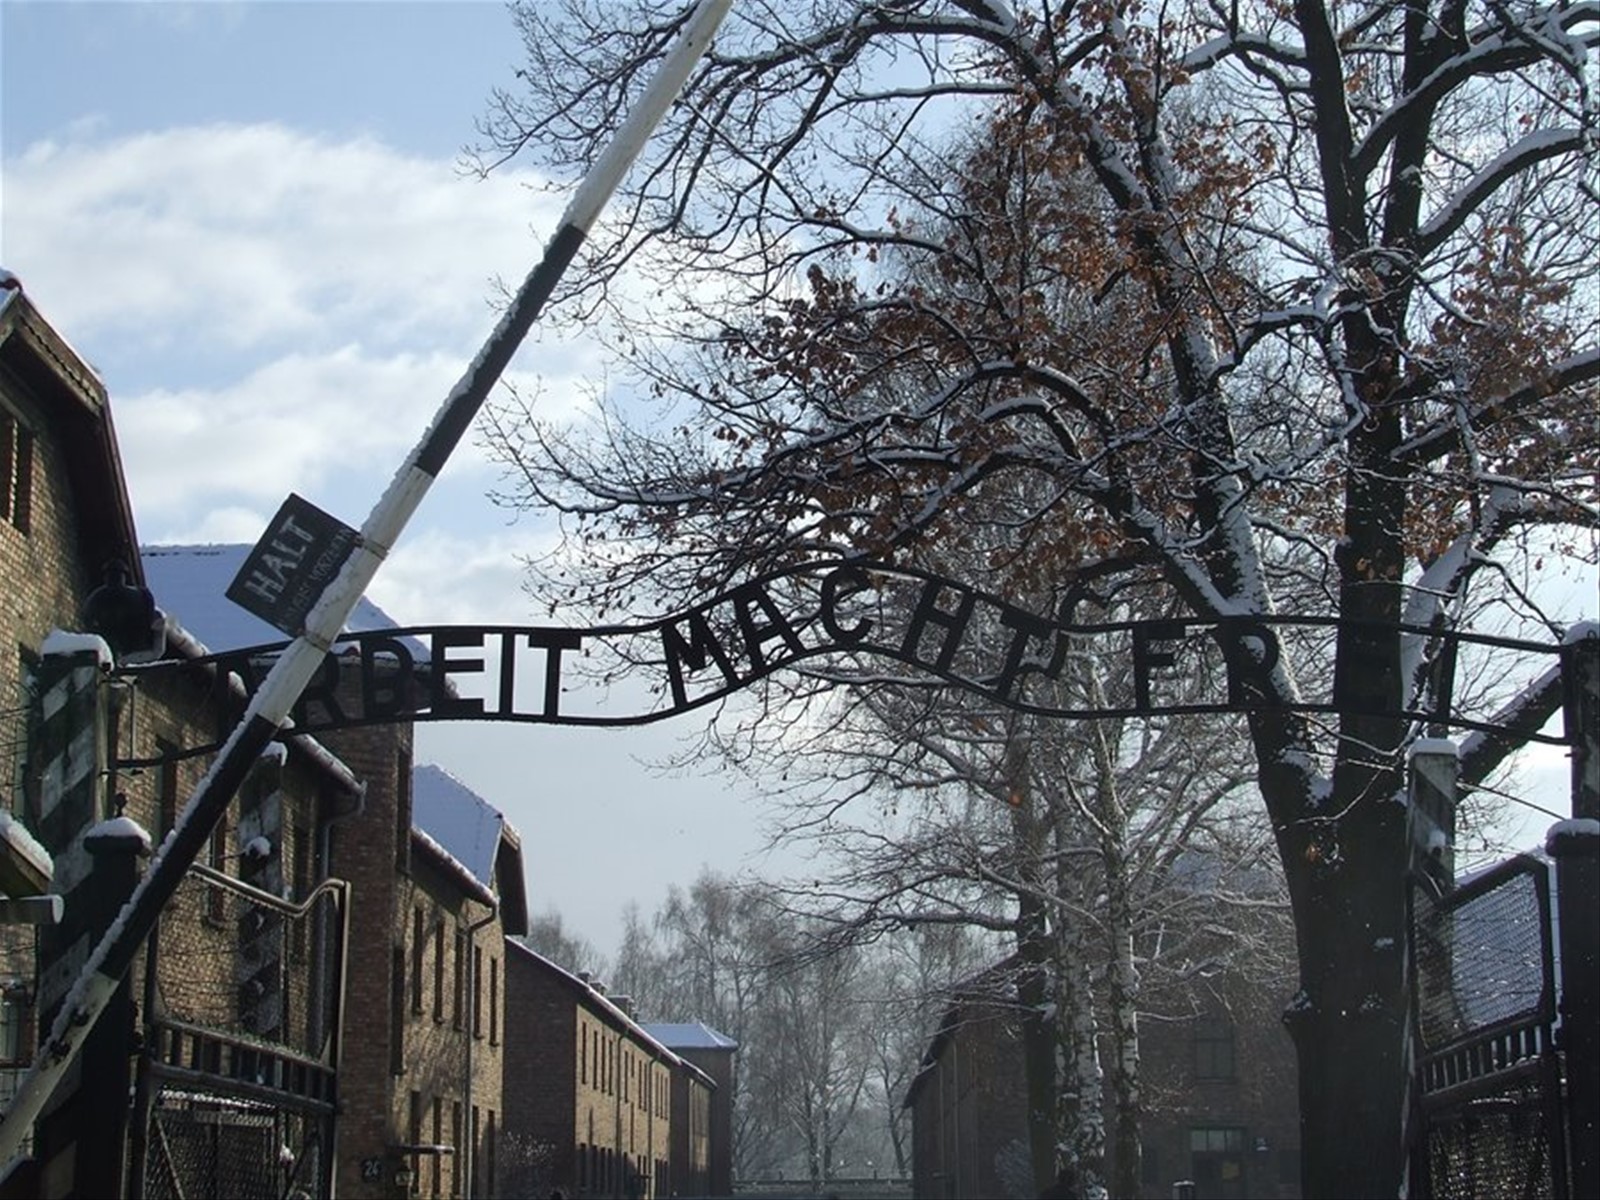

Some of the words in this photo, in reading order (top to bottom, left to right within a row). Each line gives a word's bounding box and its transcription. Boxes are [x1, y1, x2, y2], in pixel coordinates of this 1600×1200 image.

[244, 513, 315, 604] HALT
[660, 560, 1054, 709] MACHT
[1131, 622, 1457, 716] FRI
